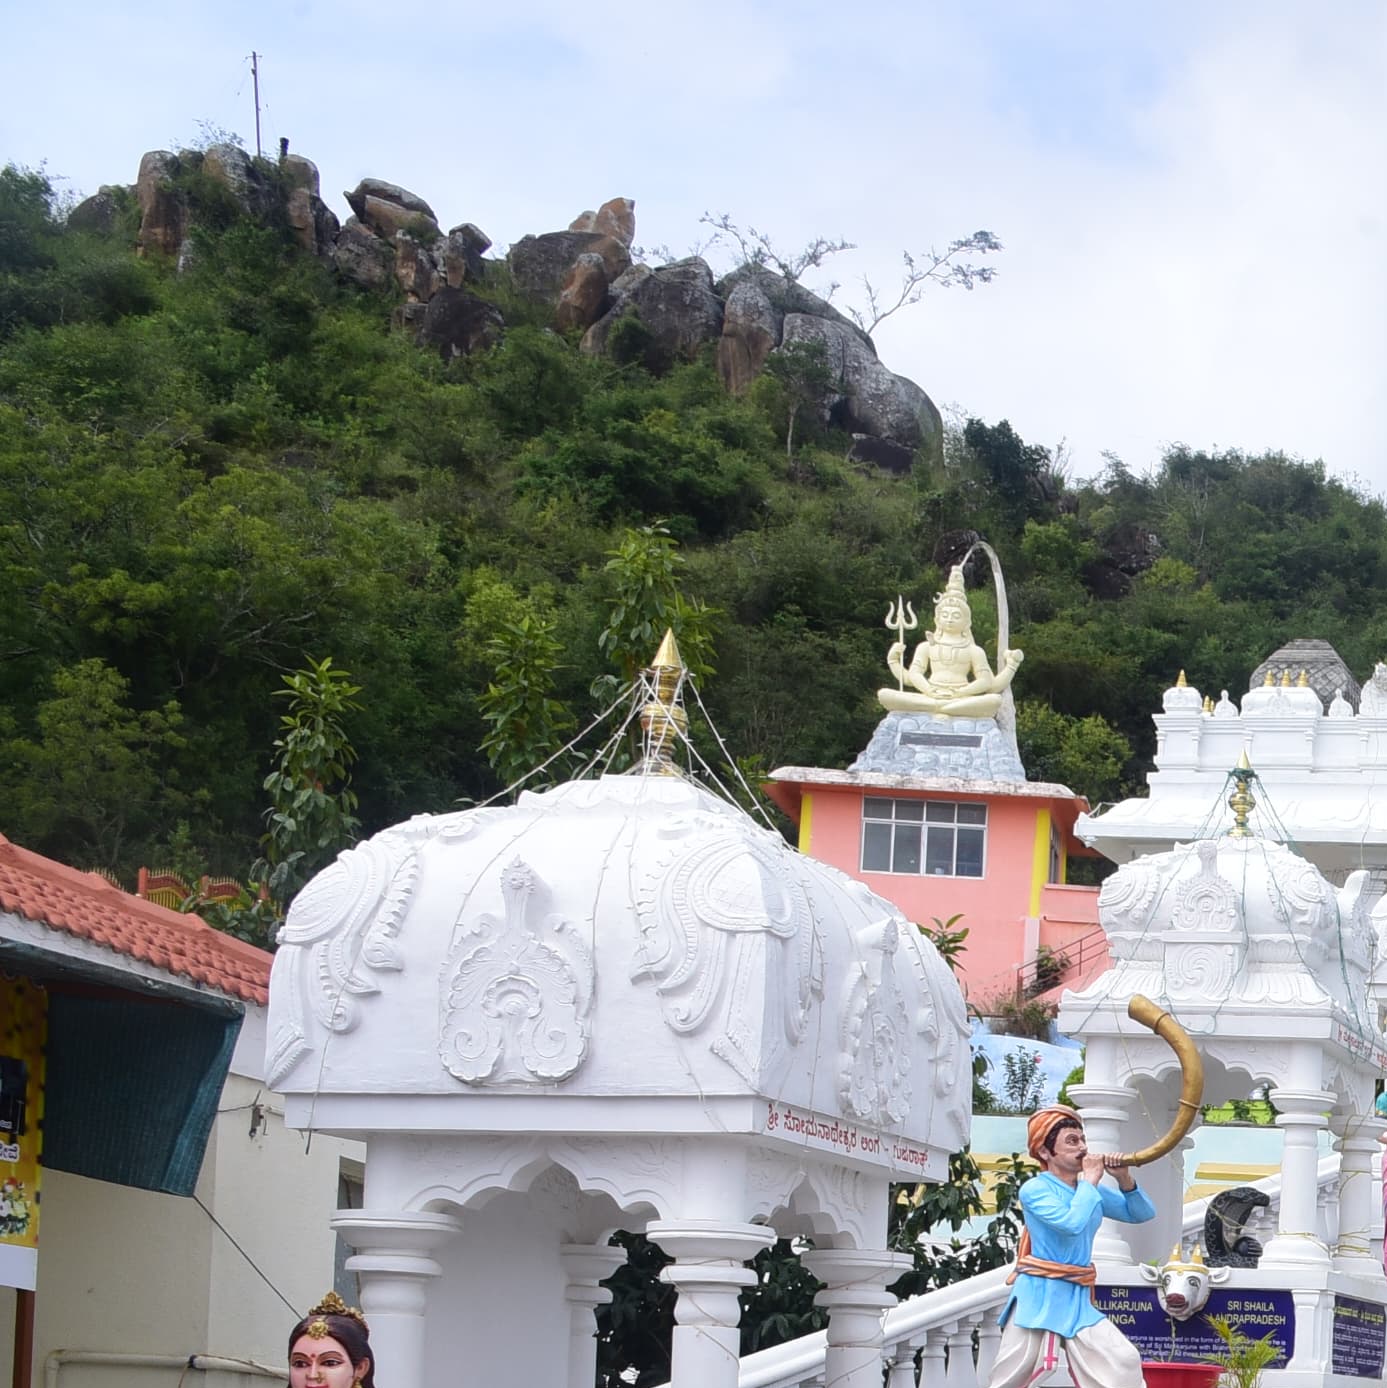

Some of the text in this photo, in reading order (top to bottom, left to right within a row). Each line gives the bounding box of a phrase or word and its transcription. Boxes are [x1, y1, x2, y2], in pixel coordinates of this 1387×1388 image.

[1111, 1288, 1128, 1298] SRI
[1094, 1300, 1153, 1312] ALLIKARJUNA
[1227, 1300, 1275, 1312] SRI SHAILA
[1107, 1314, 1136, 1325] INGA
